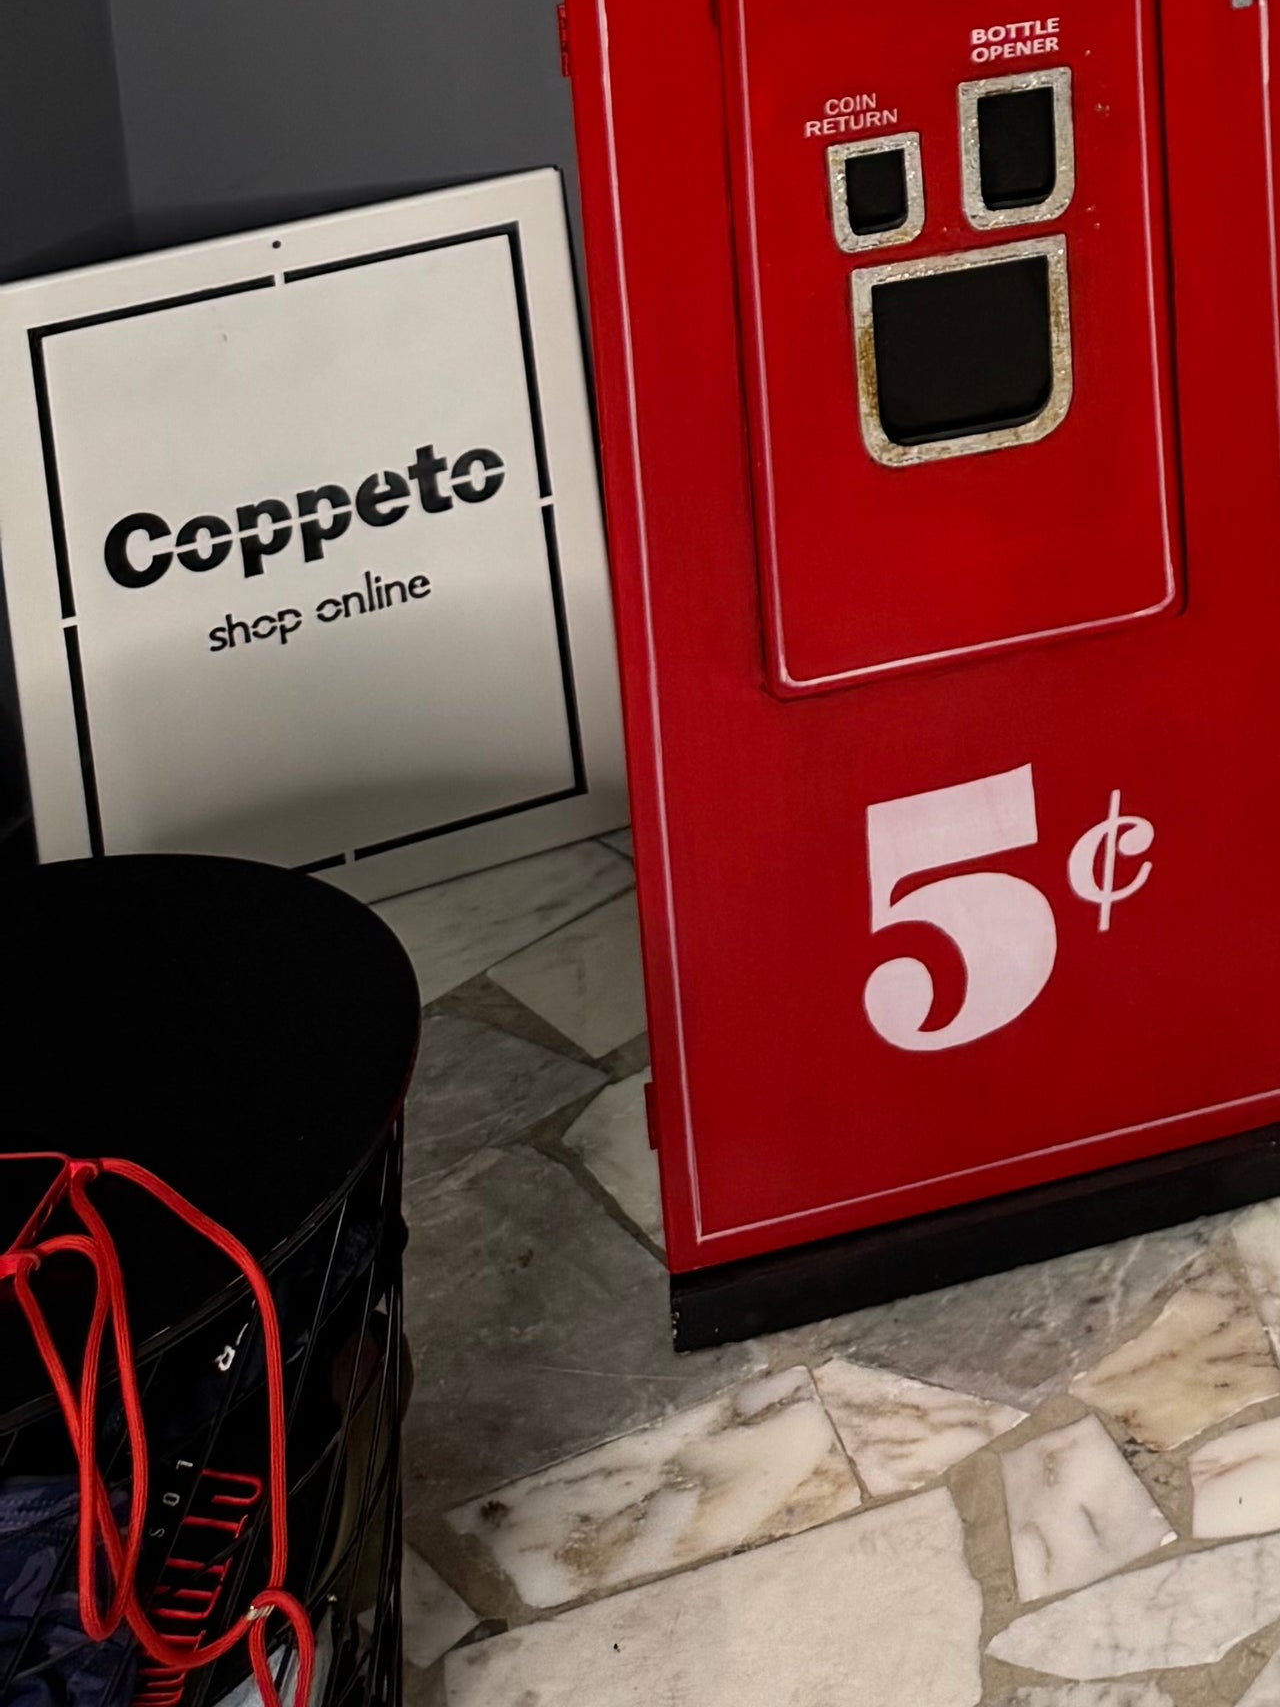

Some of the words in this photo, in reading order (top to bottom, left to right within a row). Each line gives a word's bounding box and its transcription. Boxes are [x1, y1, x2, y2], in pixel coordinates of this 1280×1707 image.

[971, 17, 1060, 45] BOTTLE
[971, 37, 1060, 63] OPENER
[824, 92, 877, 116] COIN
[804, 107, 899, 139] RETURN
[104, 444, 505, 588] Coppeto
[209, 608, 302, 651] shop
[316, 571, 431, 622] online
[864, 762, 1155, 1052] 5¢
